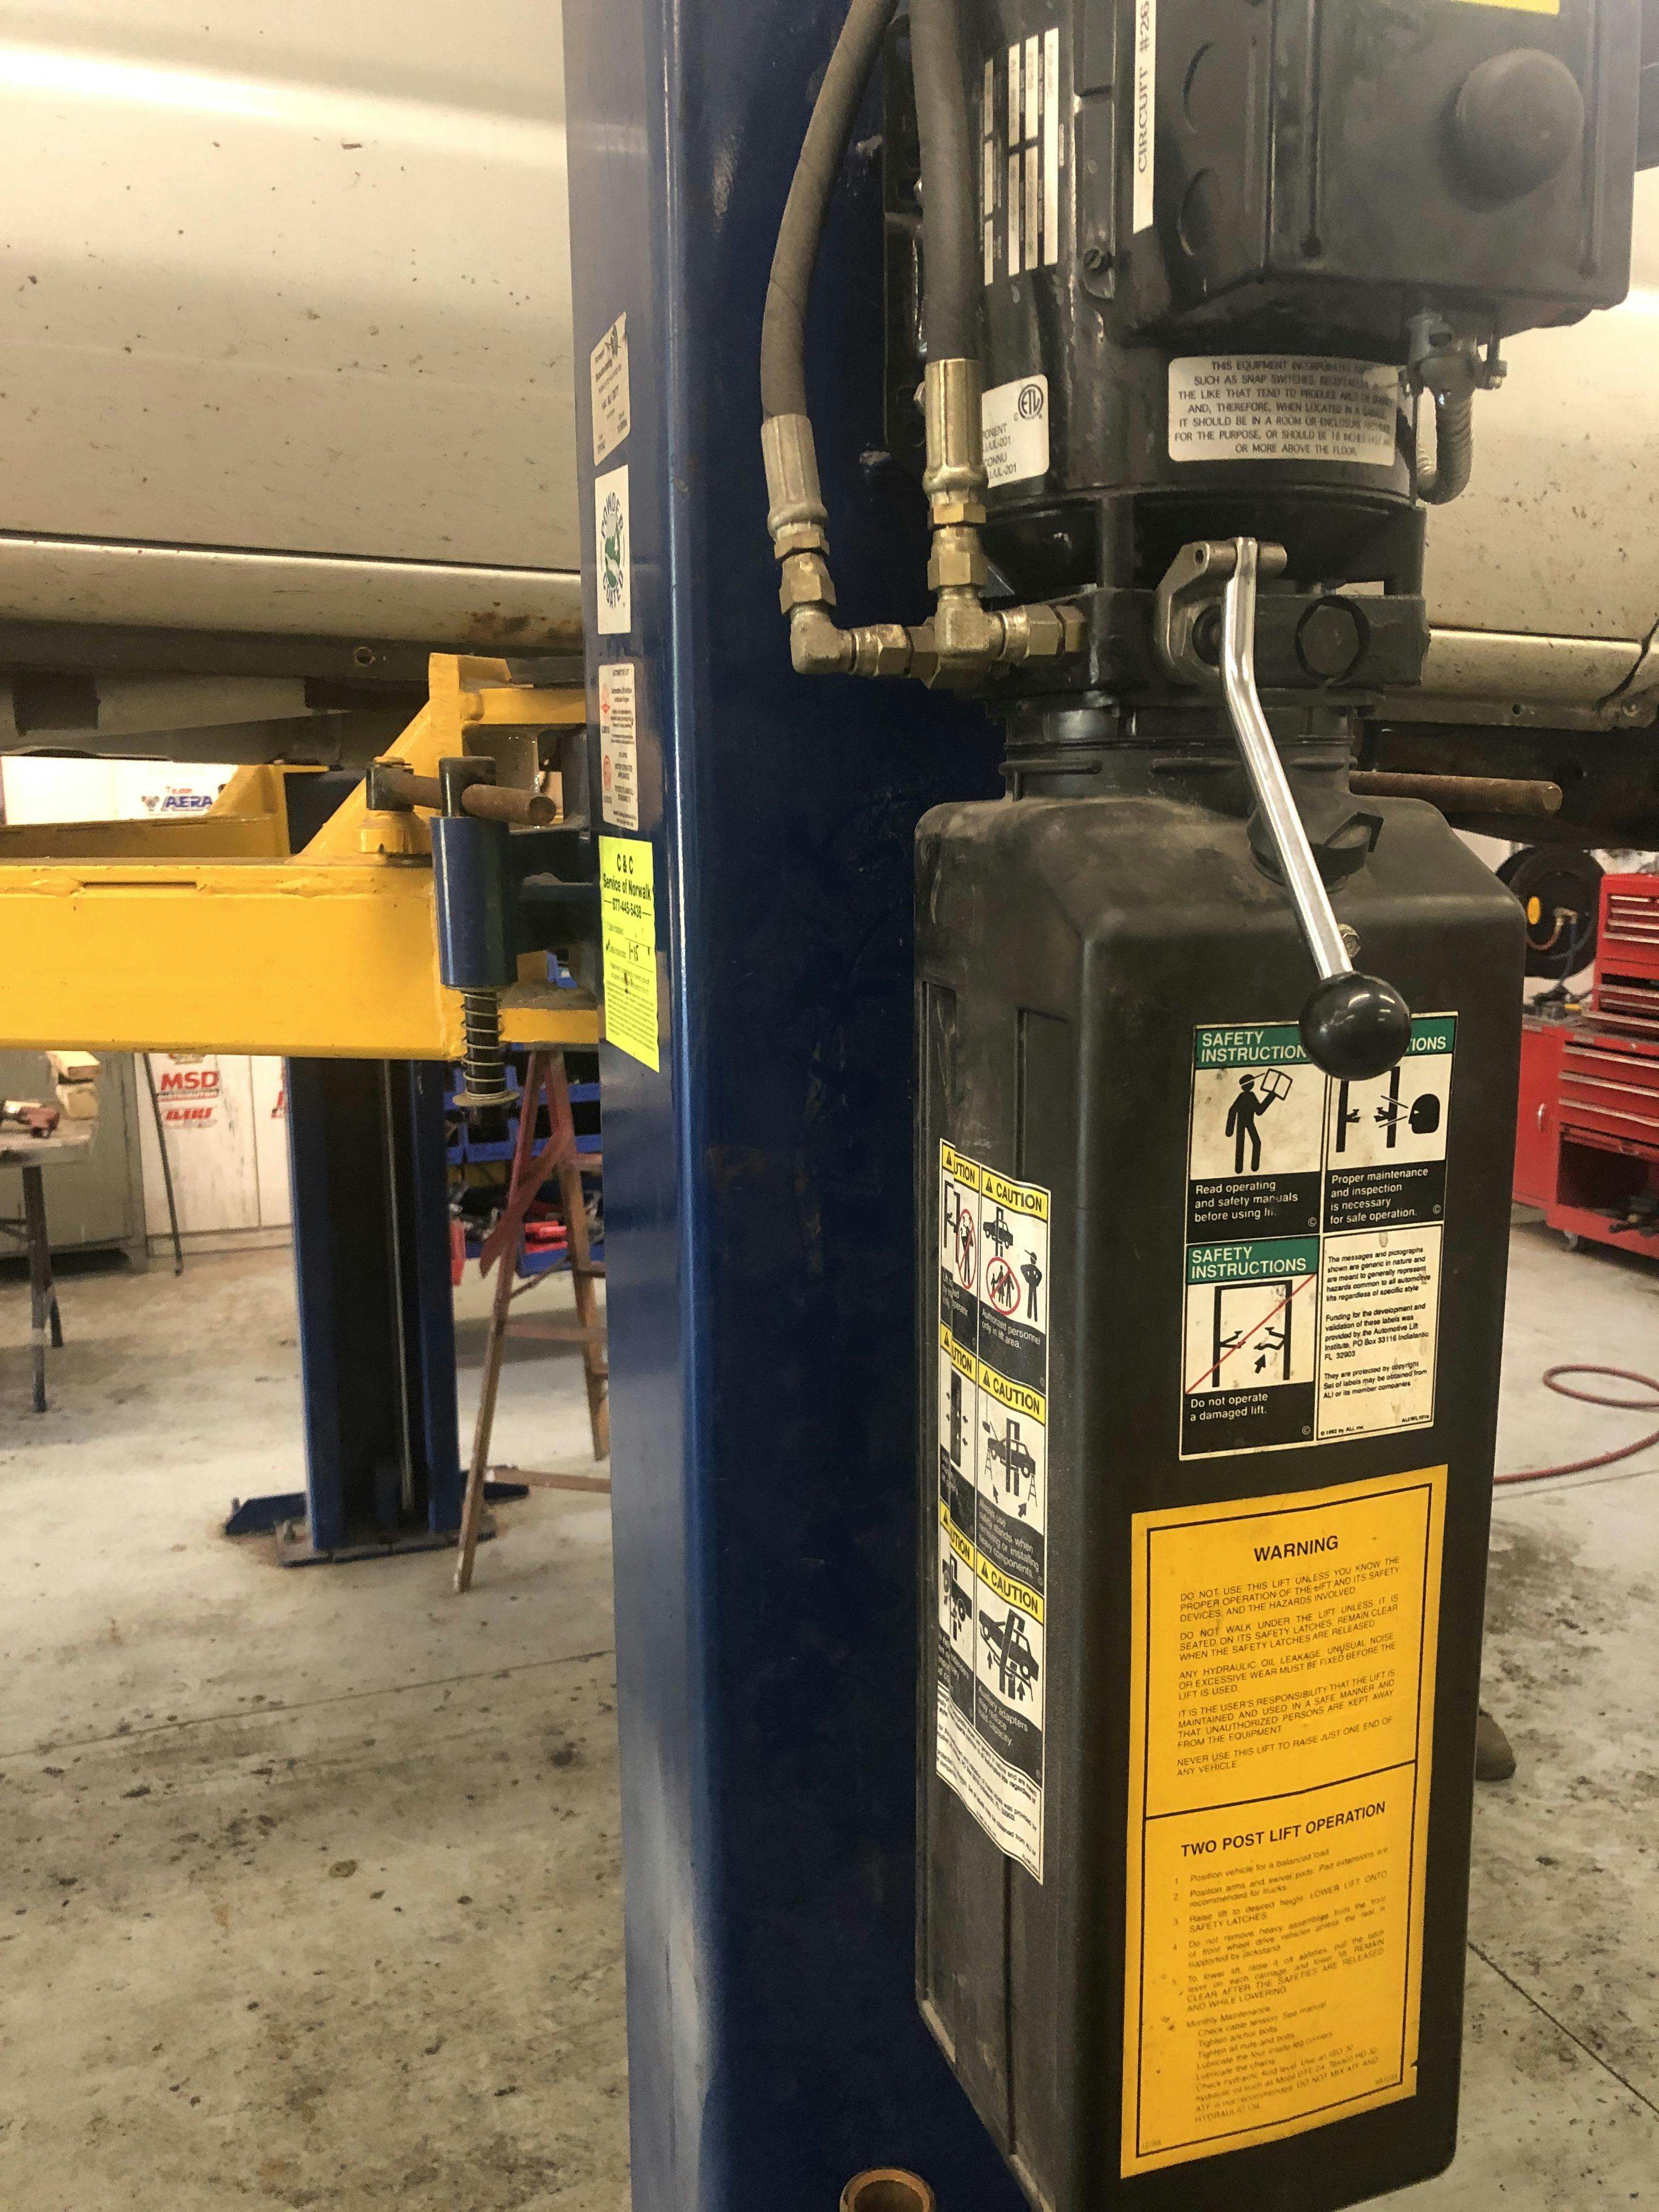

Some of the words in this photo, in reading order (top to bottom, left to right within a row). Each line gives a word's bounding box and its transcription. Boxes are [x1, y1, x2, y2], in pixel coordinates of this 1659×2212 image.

[1138, 67, 1148, 173] CIRCUIT
[1212, 360, 1232, 370] THIS
[1194, 375, 1220, 386] SUCH
[1224, 375, 1237, 384] AS
[1242, 375, 1267, 383] SNAP
[1178, 391, 1196, 399] THE
[1201, 390, 1220, 399] LIKE
[1227, 388, 1251, 398] THAT
[1257, 388, 1280, 398] TEND
[1285, 388, 1296, 398] TO
[1188, 404, 1211, 414] AND,
[1276, 402, 1301, 411] WHEN
[1180, 419, 1188, 427] IT
[1193, 417, 1231, 426] SHOULD
[1236, 416, 1247, 425] BE
[1252, 416, 1261, 425] IN
[1265, 416, 1272, 425] A
[1276, 416, 1301, 425] ROOM
[982, 422, 1007, 440] PONENT
[1175, 432, 1193, 442] FOR
[1197, 431, 1215, 440] THE
[1266, 430, 1278, 439] OR
[1282, 430, 1314, 439] SHOULD
[1235, 443, 1248, 453] OR
[1253, 443, 1277, 453] MORE
[1282, 444, 1310, 453] ABOVE
[1316, 444, 1329, 454] THE
[984, 452, 1007, 467] CONNU
[162, 795, 213, 810] AERA
[617, 854, 621, 872] C
[623, 855, 627, 873] &
[629, 856, 633, 874] C
[603, 873, 621, 892] Service
[622, 878, 627, 894] of
[629, 879, 651, 901] Norwalk
[1203, 1031, 1263, 1046] SAFETY
[1201, 1045, 1306, 1062] INSTRUCTION
[161, 1070, 219, 1090] MSD
[954, 1160, 975, 1183] UTION
[1332, 1175, 1364, 1185] Proper
[1368, 1169, 1428, 1180] maintenance
[1196, 1184, 1222, 1194] Read
[1226, 1182, 1276, 1193] operating
[1331, 1188, 1348, 1198] and
[1352, 1184, 1402, 1195] inspection
[996, 1182, 1042, 1212] CAUTION
[1195, 1198, 1214, 1208] and
[1218, 1197, 1249, 1206] safety
[1342, 1199, 1391, 1209] necessary
[1195, 1212, 1228, 1222] before
[1232, 1210, 1260, 1220] using
[1330, 1216, 1343, 1224] for
[1347, 1212, 1366, 1222] safe
[1370, 1209, 1417, 1221] operation.
[1193, 1246, 1252, 1263] SAFETY
[1192, 1258, 1306, 1278] INSTRUCTIONS
[981, 1321, 992, 1334] only
[1005, 1336, 1021, 1348] area.
[982, 1308, 1007, 1331] Authorized
[1008, 1325, 1041, 1345] personnel
[952, 1346, 972, 1374] UTION
[993, 1378, 1040, 1415] CAUTION
[1191, 1399, 1205, 1408] Do
[1209, 1397, 1224, 1406] not
[1229, 1393, 1268, 1405] operate
[1200, 1407, 1247, 1420] damaged
[1251, 1406, 1266, 1414] lift.
[950, 1526, 970, 1560] UTION
[1015, 1538, 1034, 1554] when
[1254, 1536, 1338, 1561] WARNING
[1011, 1547, 1039, 1573] installing
[1181, 1592, 1194, 1601] DO
[1224, 1585, 1241, 1595] USE
[1248, 1582, 1267, 1590] THIS
[1273, 1578, 1289, 1588] LIFT
[1296, 1571, 1329, 1584] UNLESS
[1334, 1567, 1351, 1576] YOU
[1356, 1561, 1380, 1570] KNOW
[1385, 1556, 1399, 1565] THE
[991, 1571, 1038, 1614] CAUTION
[1181, 1599, 1219, 1611] PROPER
[1223, 1592, 1277, 1605] OPERATION
[1279, 1589, 1291, 1597] OF
[1295, 1585, 1311, 1594] THE
[1334, 1577, 1351, 1587] AND
[1354, 1574, 1366, 1582] ITS
[1369, 1567, 1398, 1579] SAFETY
[1226, 1606, 1245, 1615] AND
[1249, 1603, 1266, 1611] THE
[1269, 1596, 1311, 1609] HAZARDS
[1315, 1587, 1356, 1601] INVOLVED
[998, 1707, 1028, 1732] adapters
[1177, 1755, 1208, 1765] NEVER
[1212, 1752, 1229, 1762] USE
[1234, 1748, 1254, 1756] THIS
[1257, 1744, 1274, 1753] LIFT
[1294, 1736, 1317, 1747] RAISE
[1321, 1730, 1339, 1741] JUST
[1344, 1725, 1359, 1735] ONE
[1364, 1720, 1379, 1730] END
[1382, 1716, 1392, 1725] OF
[1199, 1760, 1236, 1773] VEHICLE
[1181, 1841, 1216, 1857] TWO
[1223, 1832, 1265, 1850] POST
[1271, 1825, 1301, 1842] LIFT
[1306, 1802, 1385, 1833] OPERATION
